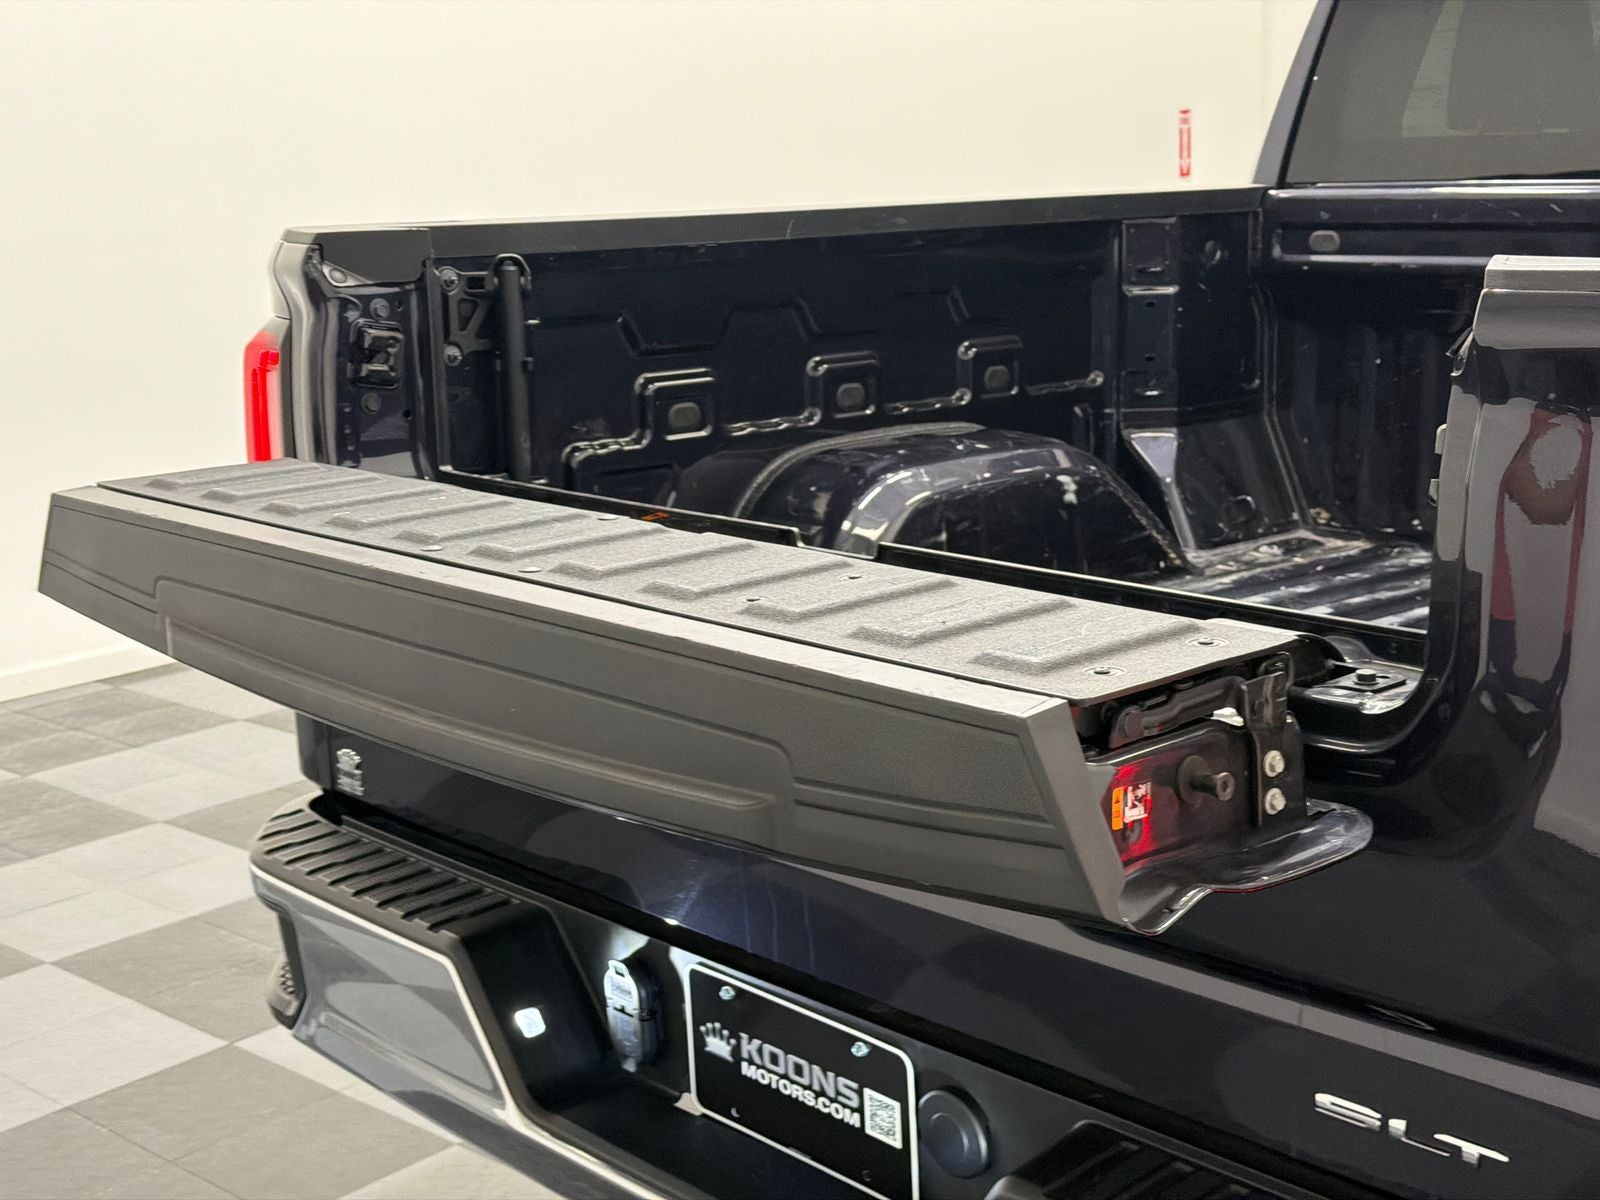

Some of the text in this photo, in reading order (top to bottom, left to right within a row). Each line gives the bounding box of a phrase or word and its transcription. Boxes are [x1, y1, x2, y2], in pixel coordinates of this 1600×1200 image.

[739, 1031, 860, 1108] KOONS
[740, 1061, 861, 1128] MOTORS.COM
[1314, 1092, 1510, 1168] SLT
